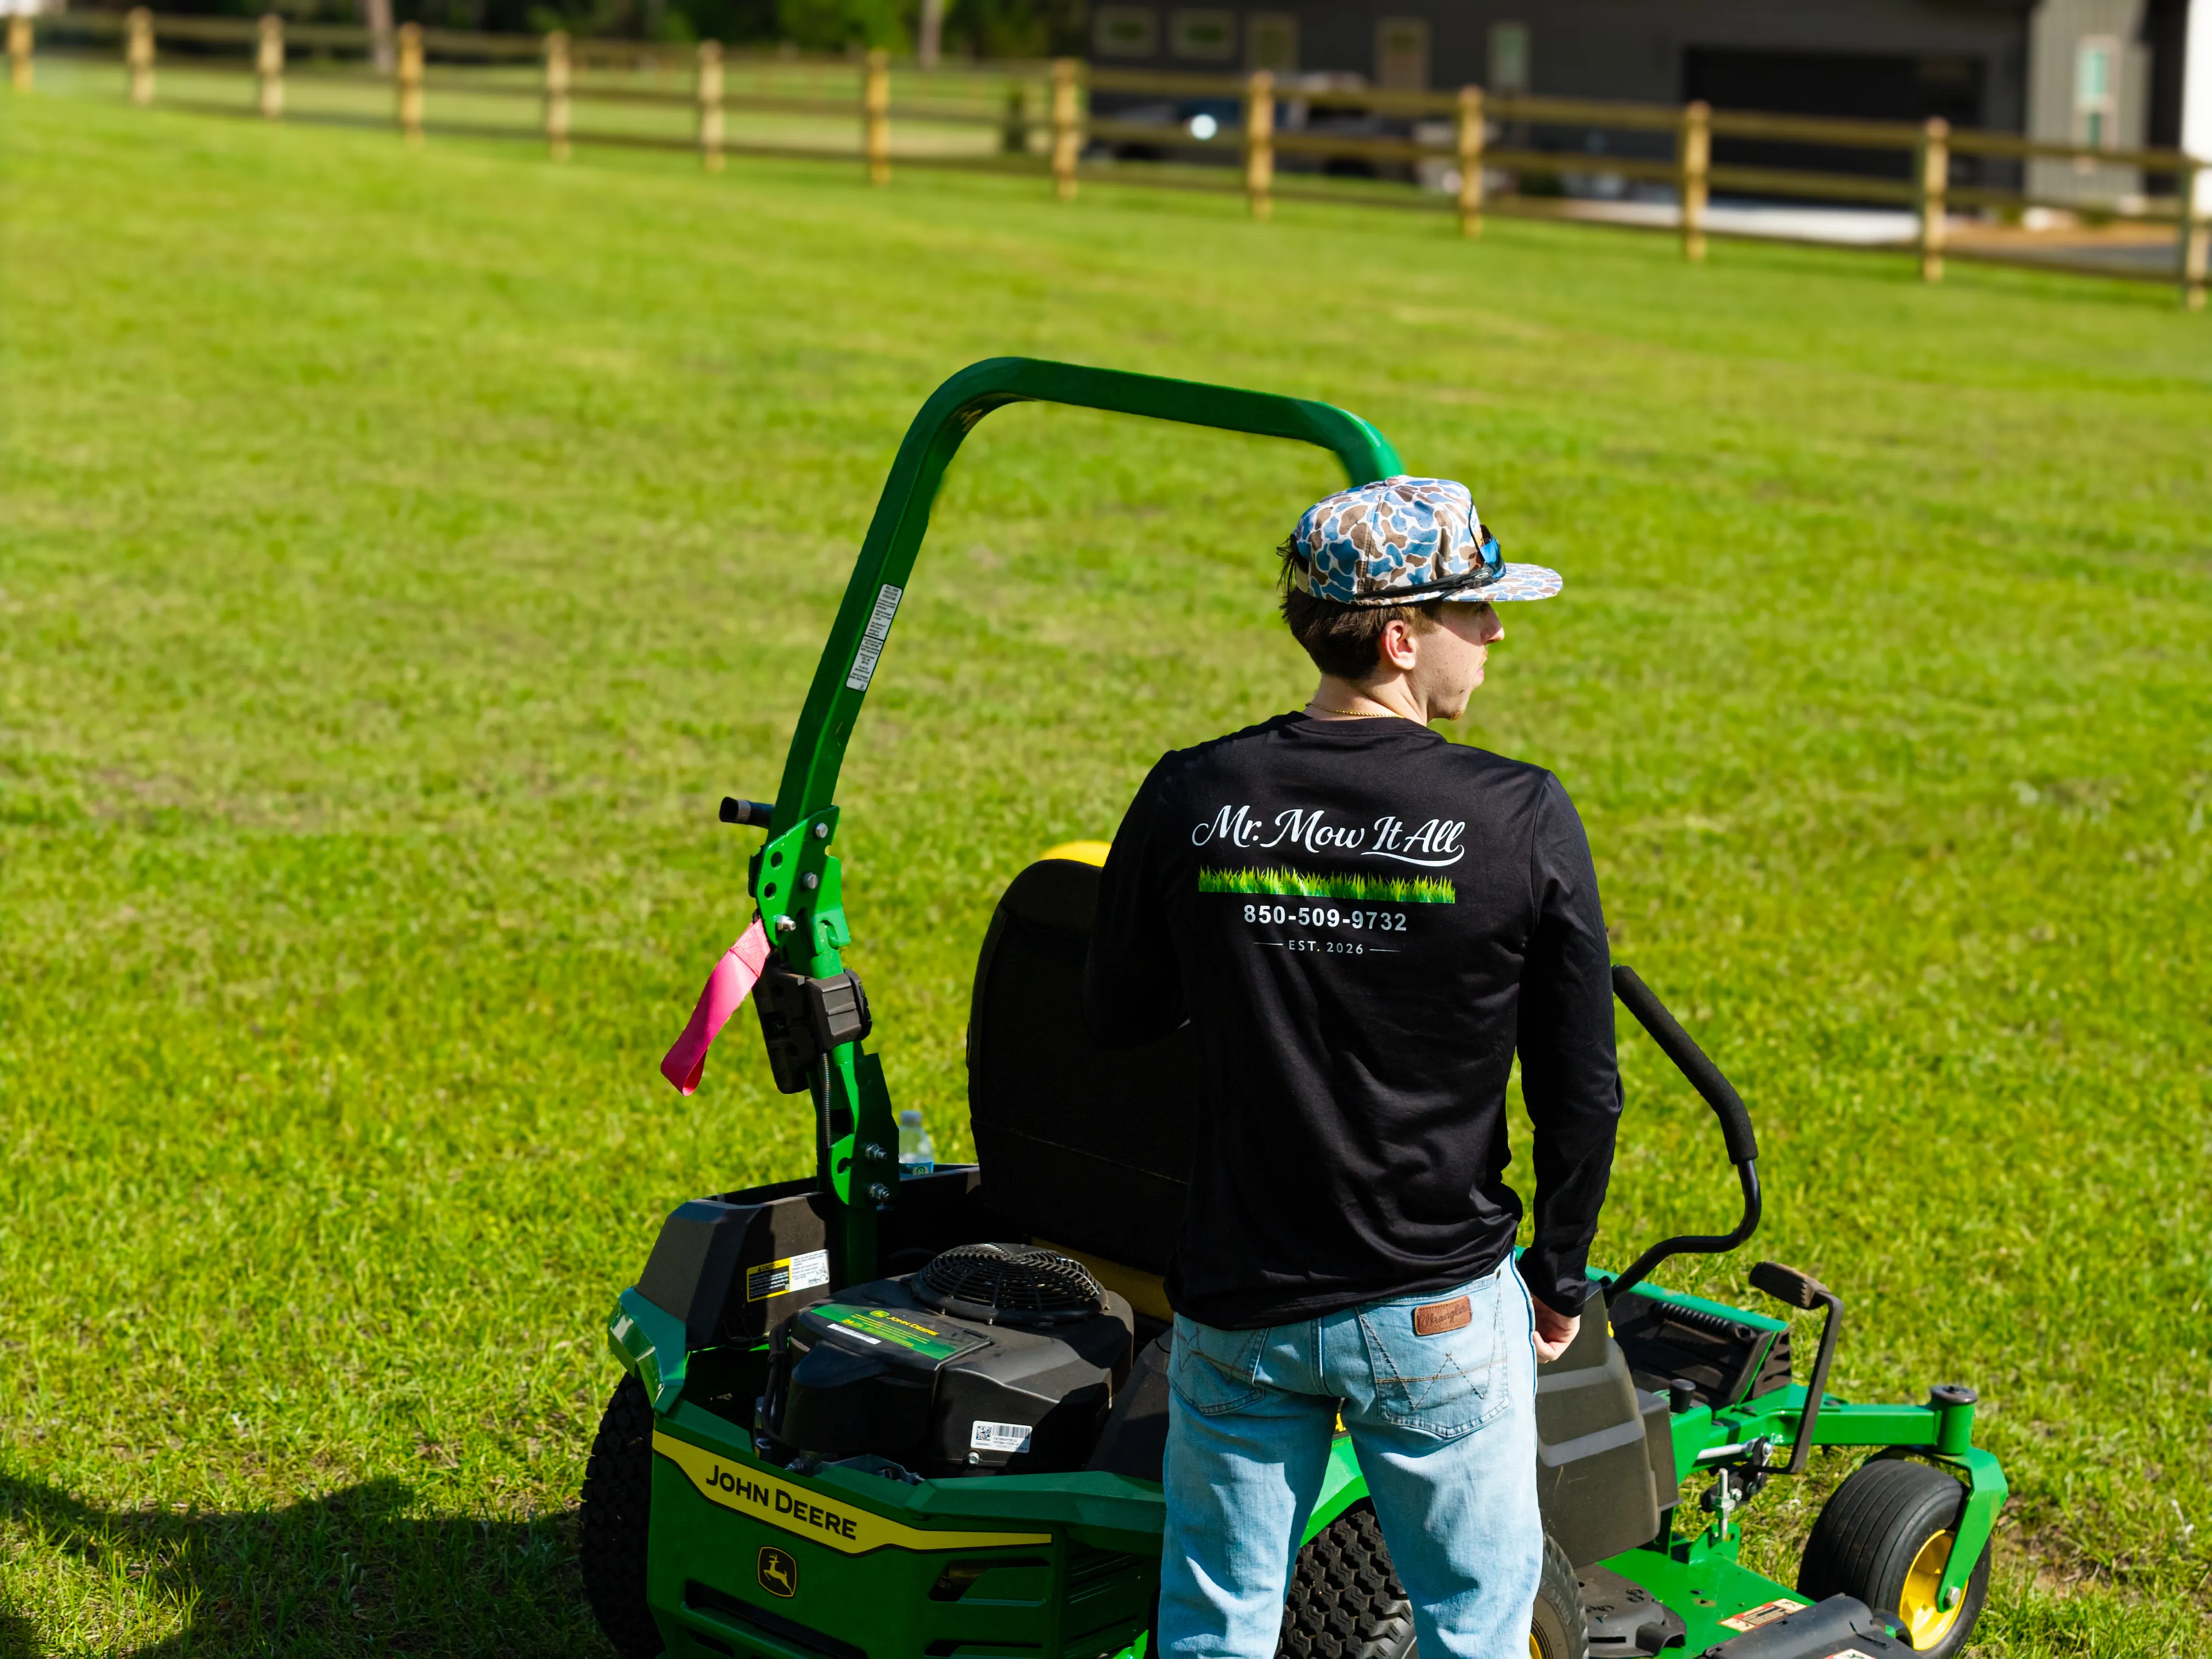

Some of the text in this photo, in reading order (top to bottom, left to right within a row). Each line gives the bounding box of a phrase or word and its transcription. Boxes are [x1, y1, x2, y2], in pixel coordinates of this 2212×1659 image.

[1192, 805, 1466, 867] Mr. Mow It All
[1244, 904, 1407, 932] 850-509-9732
[1288, 939, 1364, 955] EST. 2026
[886, 1316, 939, 1336] JOHN DEERE
[1420, 1304, 1469, 1327] Wrangler
[706, 1464, 857, 1541] JOHN DEERE
